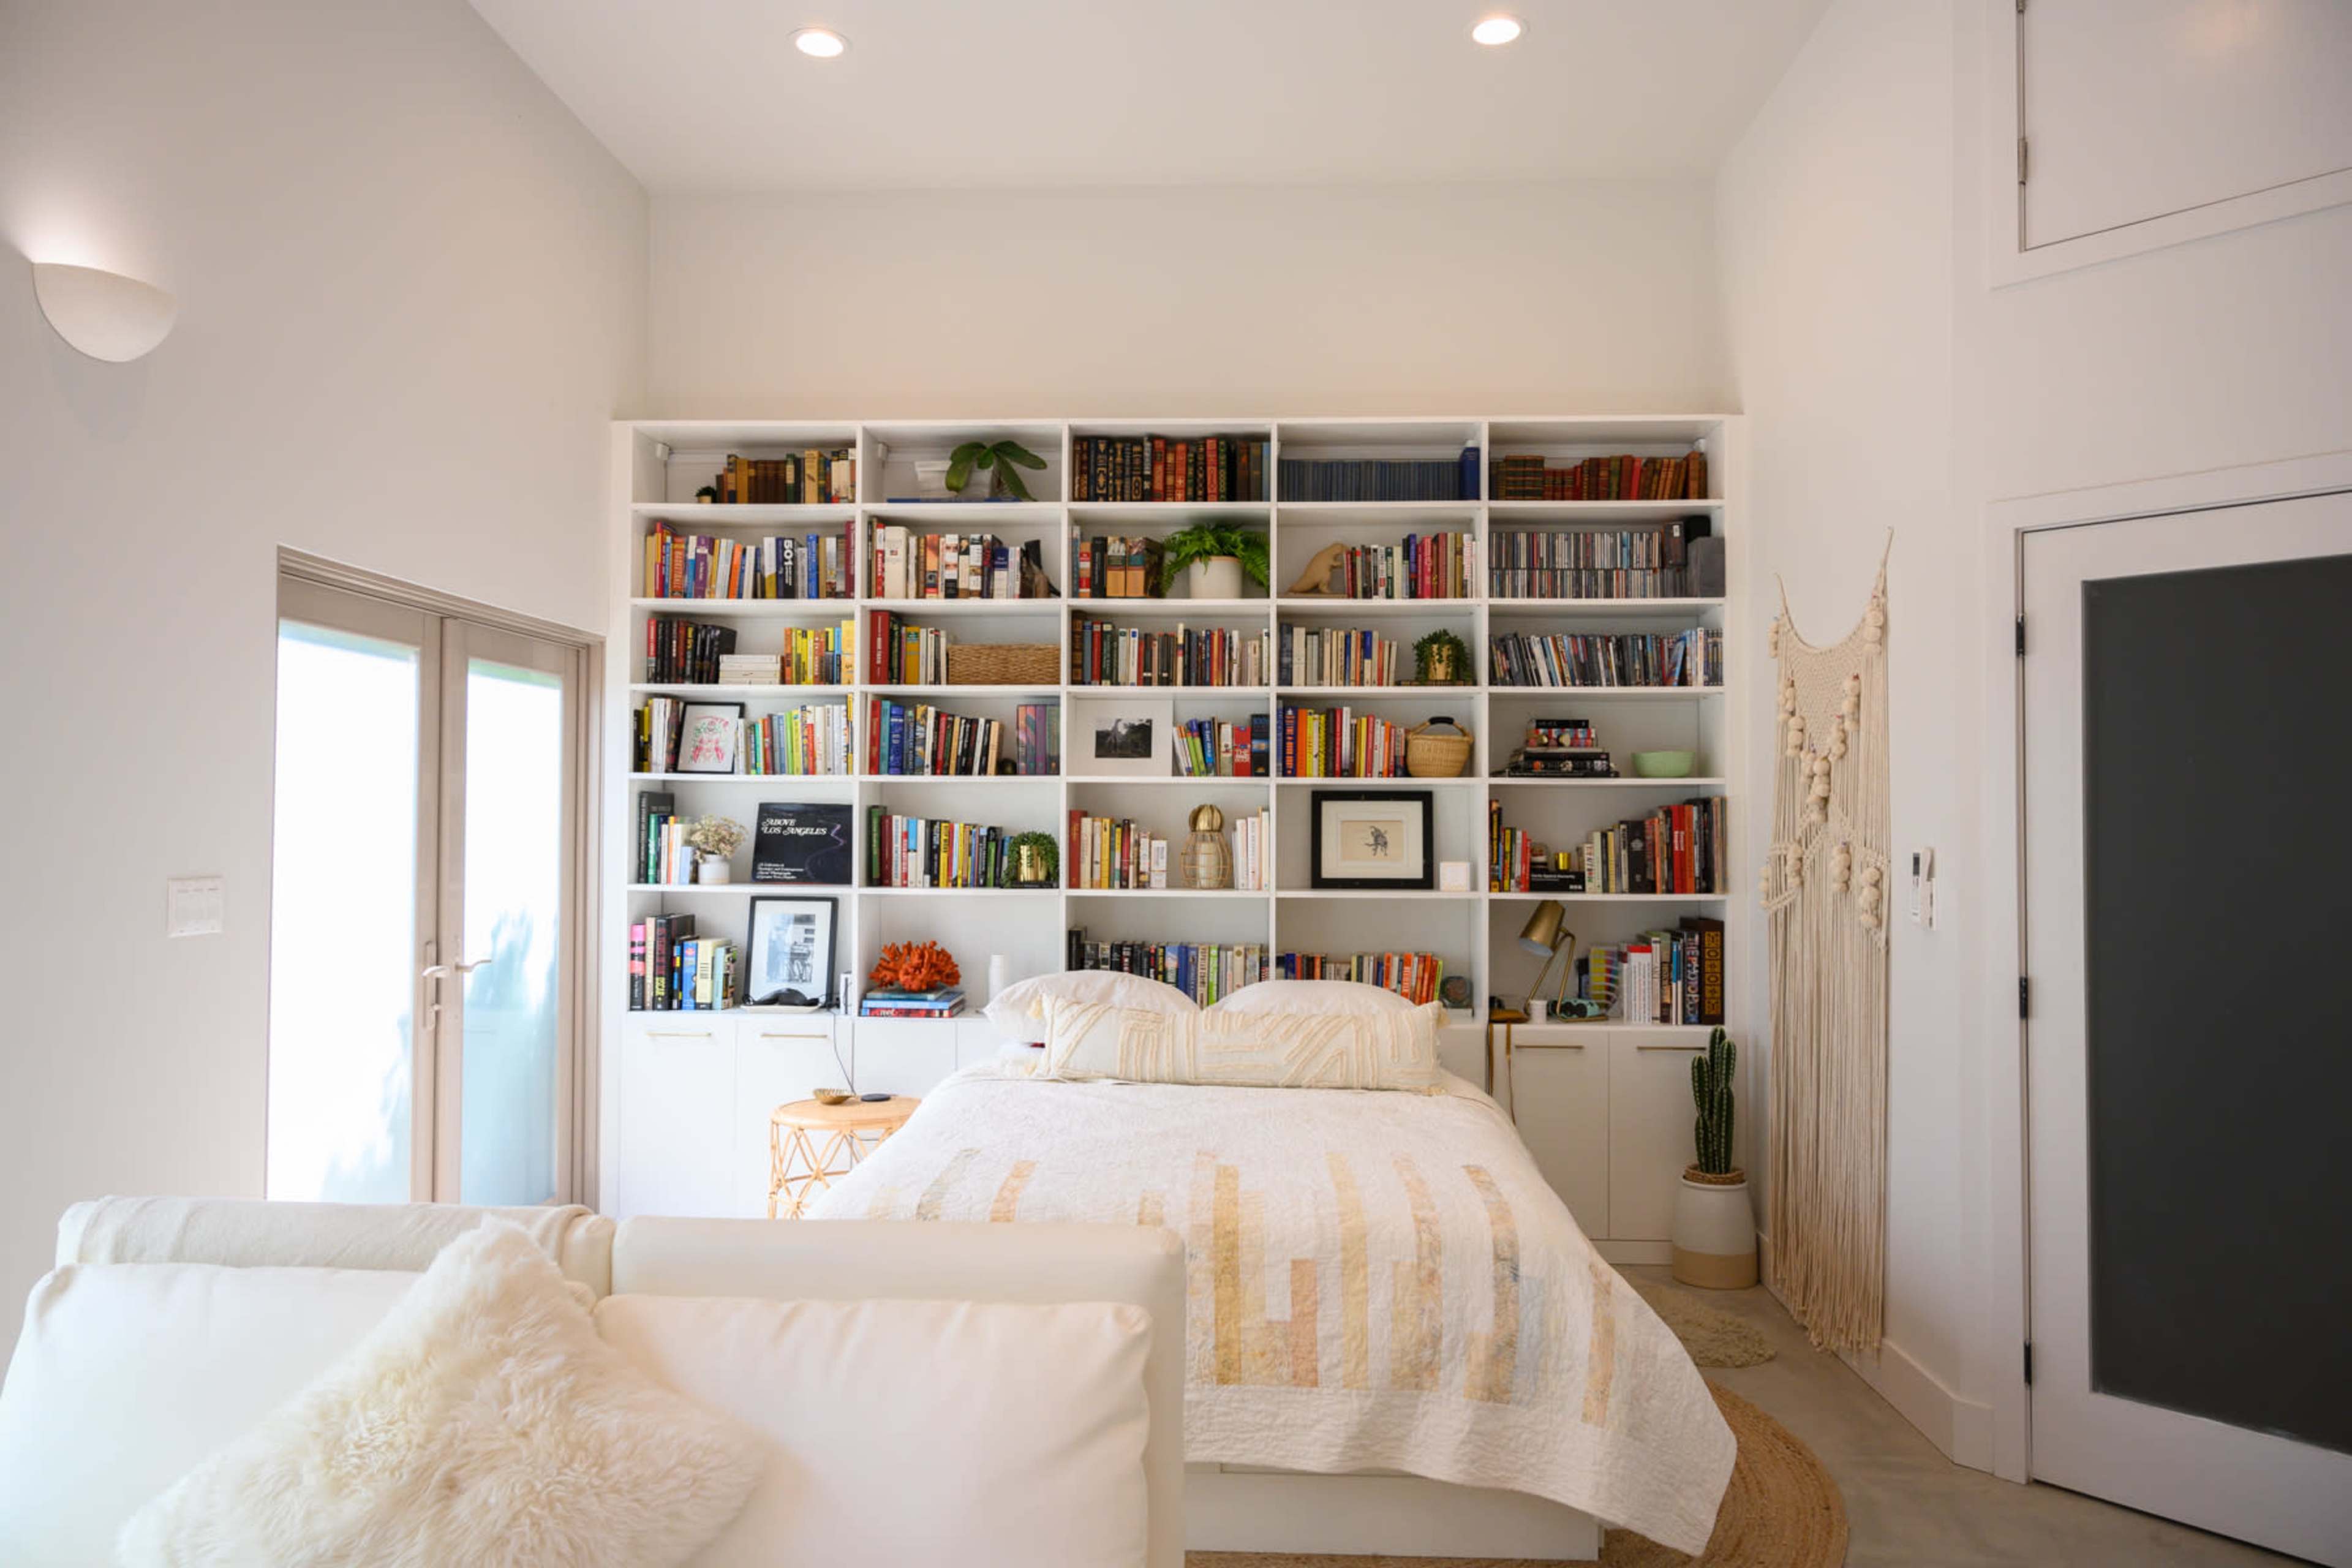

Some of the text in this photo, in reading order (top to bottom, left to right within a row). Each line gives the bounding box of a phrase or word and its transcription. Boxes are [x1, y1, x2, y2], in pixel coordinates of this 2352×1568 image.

[784, 540, 793, 565] 501
[761, 818, 796, 827] ABOVE
[783, 827, 827, 836] ANGELES
